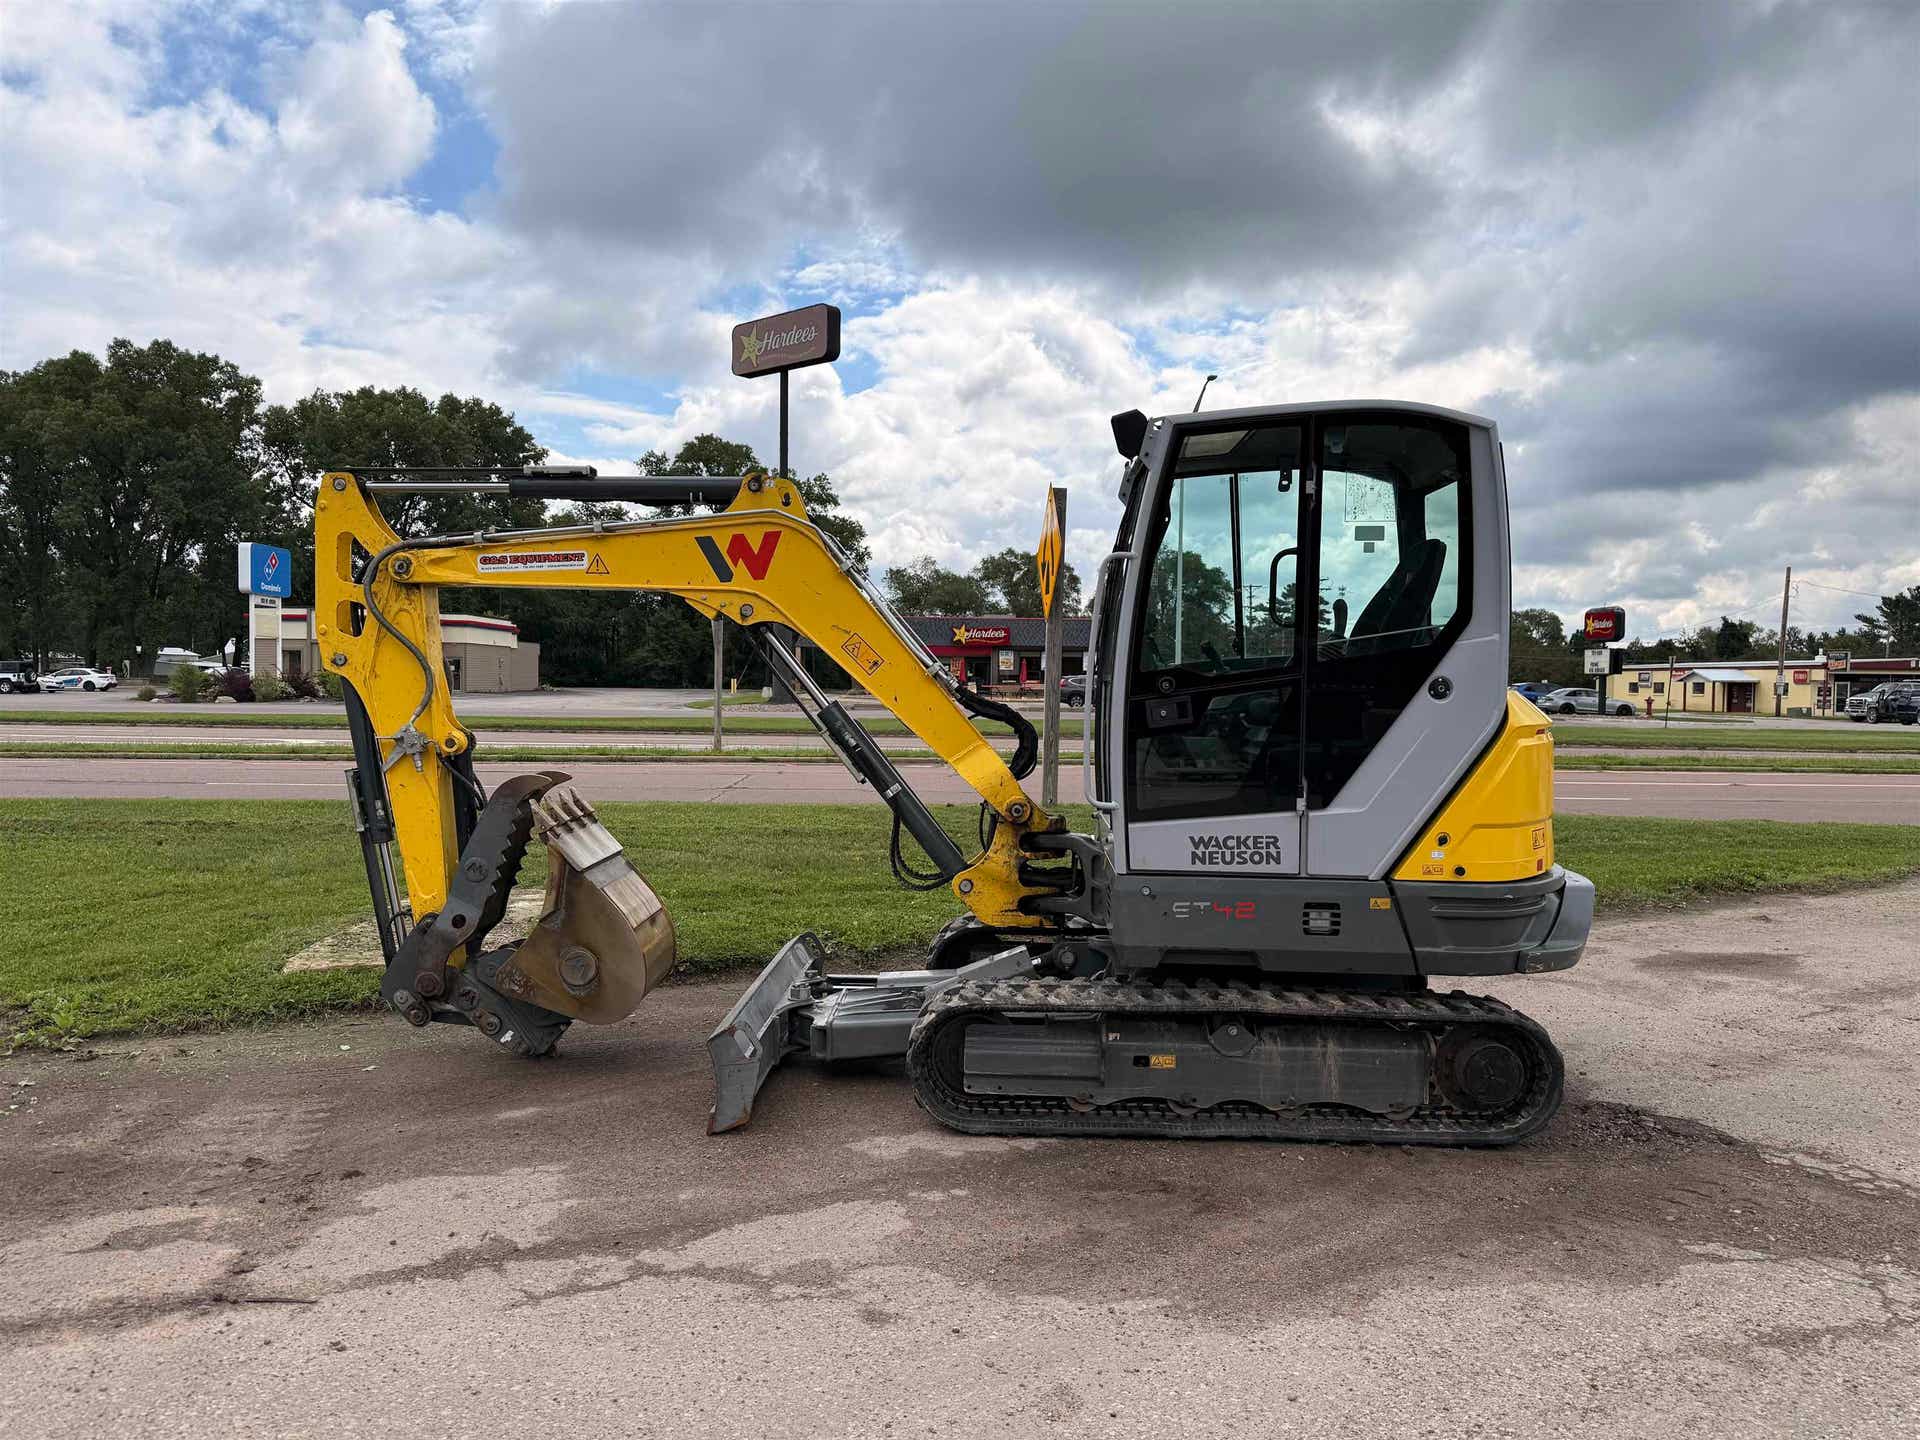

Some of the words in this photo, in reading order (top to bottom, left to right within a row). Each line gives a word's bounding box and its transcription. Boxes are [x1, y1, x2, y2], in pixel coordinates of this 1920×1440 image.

[509, 553, 585, 565] EQUIPMENT
[1188, 835, 1281, 850] WACKER
[1190, 850, 1281, 865] NEUSON
